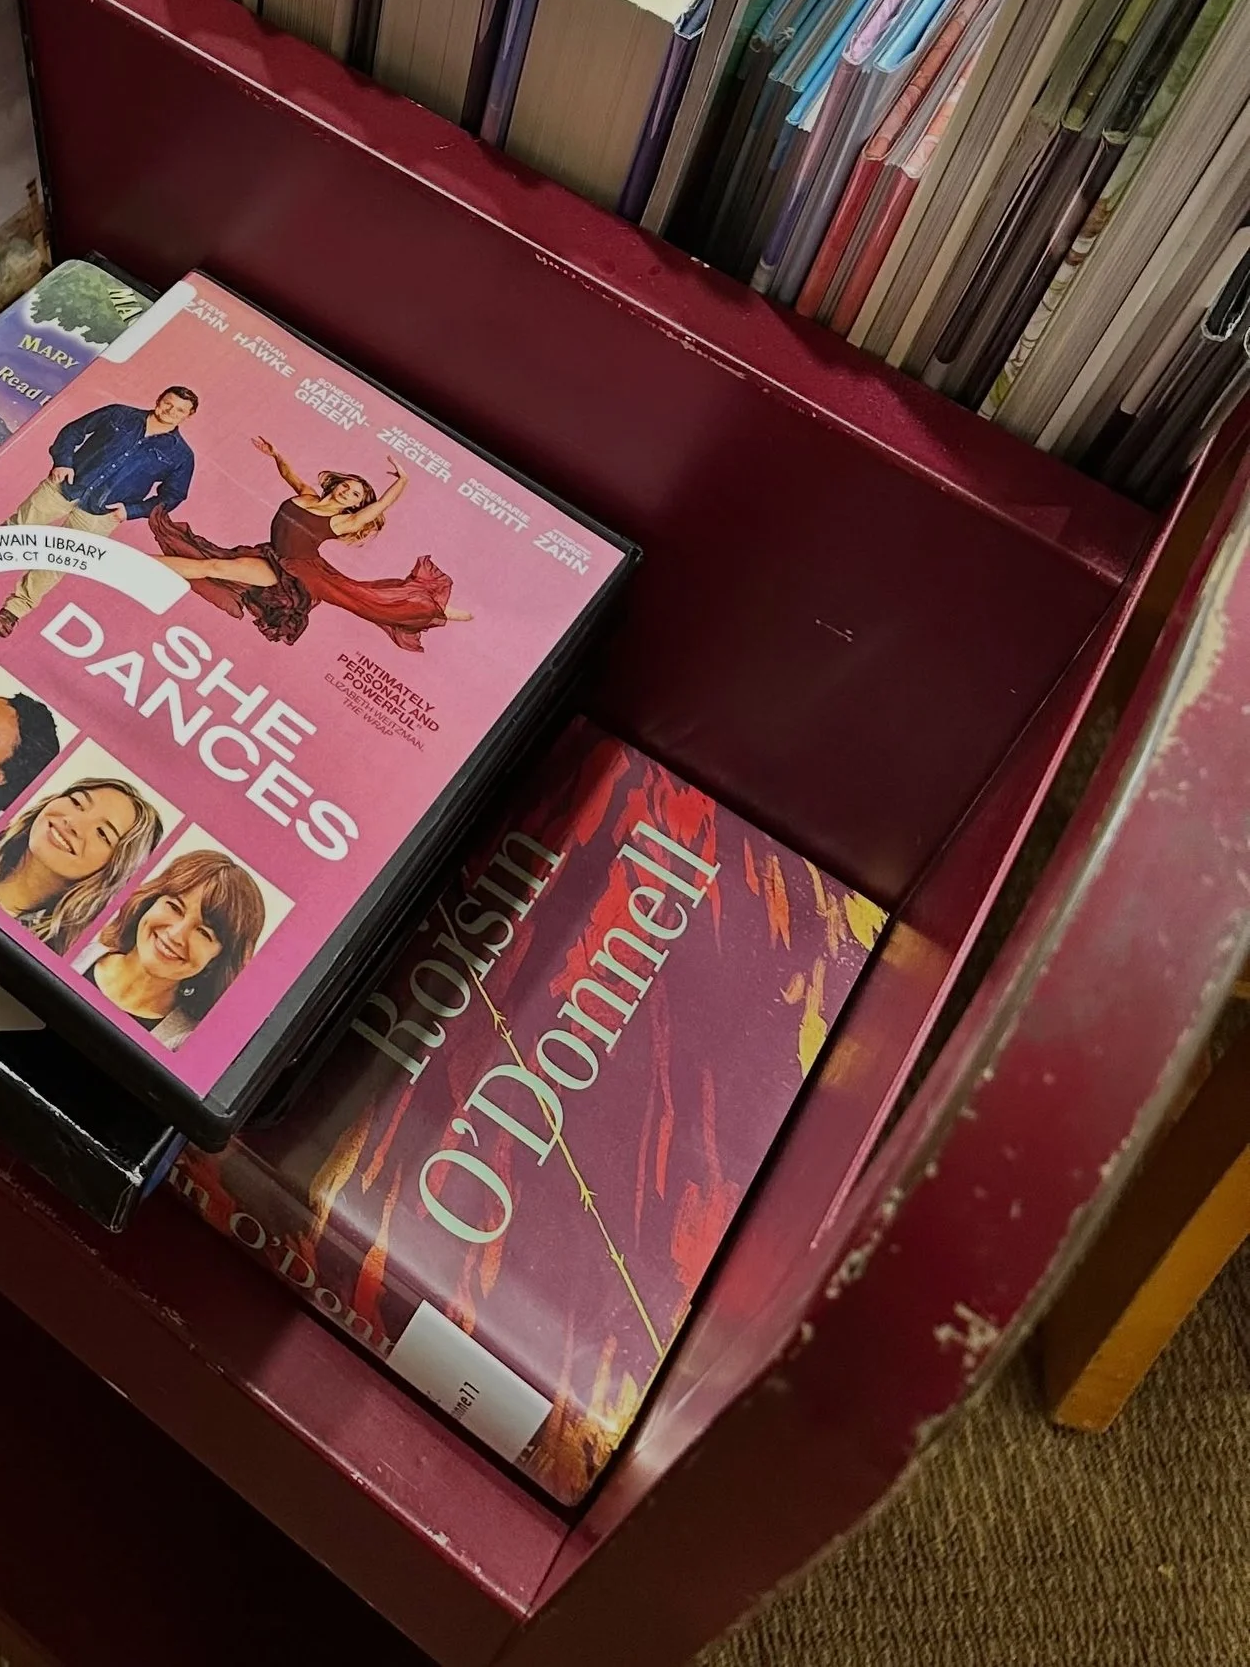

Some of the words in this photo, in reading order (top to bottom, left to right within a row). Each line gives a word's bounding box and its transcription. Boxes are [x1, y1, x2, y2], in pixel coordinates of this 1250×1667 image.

[107, 287, 144, 326] MA
[183, 300, 230, 334] ZAHN
[196, 297, 229, 321] STEVE
[17, 333, 80, 370] MARY
[233, 332, 296, 378] HAWKE
[253, 335, 288, 361] ETHAN
[293, 387, 356, 432] GREEN
[299, 378, 371, 429] MARTIN-
[316, 377, 365, 412] SONEQUA
[376, 428, 453, 485] ZIEGLER
[389, 425, 453, 470] MACKENZIE
[457, 483, 529, 535] DEWITT
[467, 476, 531, 524] ROSEMARIE
[22, 550, 39, 562] CT
[47, 552, 88, 571] 06875
[44, 535, 107, 561] LIBRARY
[533, 537, 589, 576] ZAHN
[150, 623, 317, 763] SHE
[324, 673, 375, 712] ELIZABETH
[374, 711, 425, 752] WEITZMAN,
[337, 654, 407, 711] PERSONAL
[409, 708, 440, 732] AND
[39, 602, 360, 865] DANCES
[343, 699, 364, 715] THE
[364, 714, 394, 737] WRAP
[417, 818, 722, 1243] O'Donnell
